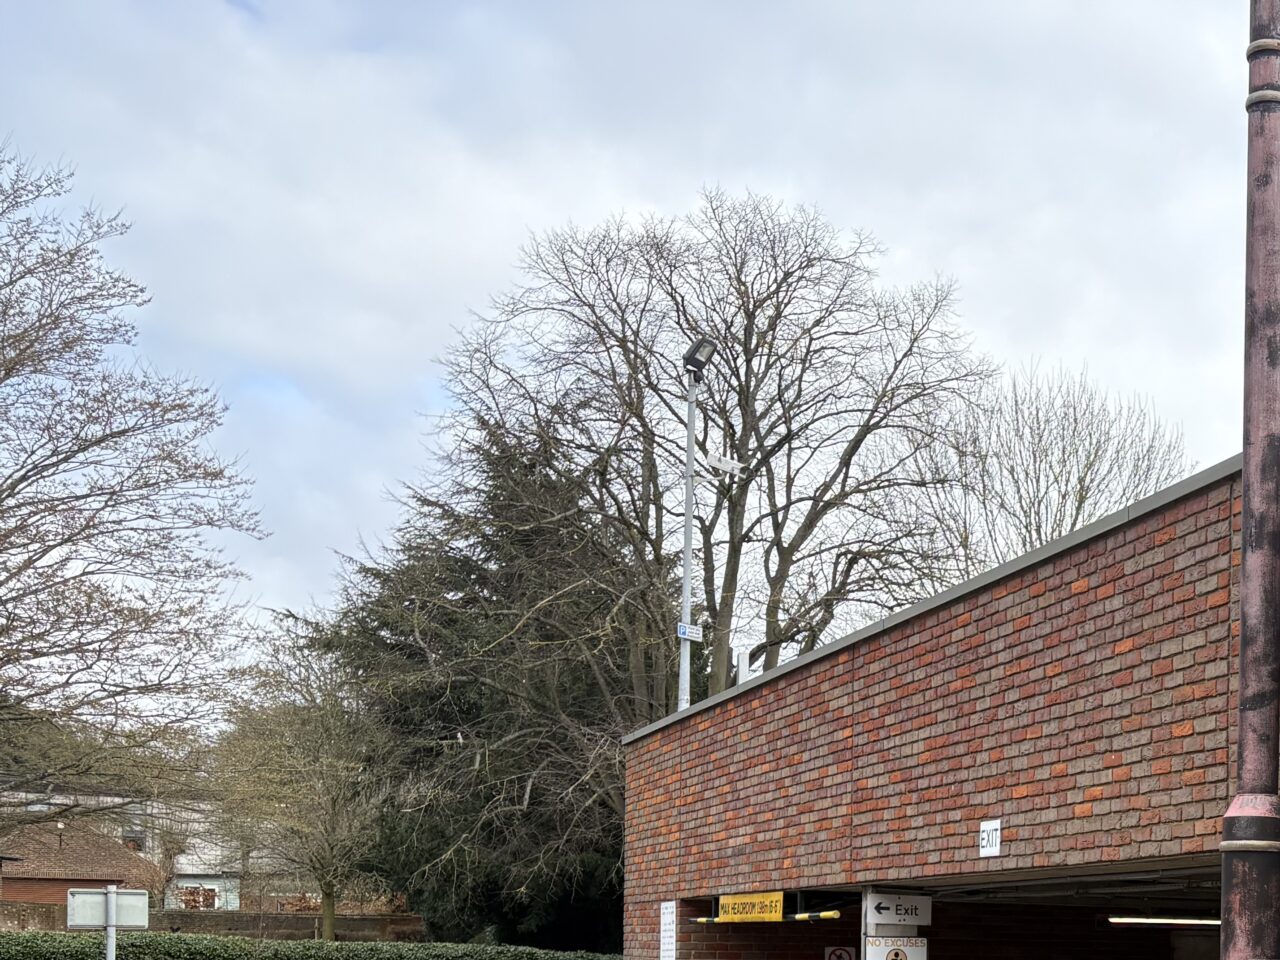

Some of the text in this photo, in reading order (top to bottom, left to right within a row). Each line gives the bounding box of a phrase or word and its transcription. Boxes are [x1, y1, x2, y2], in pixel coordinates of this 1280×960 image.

[981, 828, 999, 849] EXIT
[720, 903, 730, 916] MAX
[731, 901, 757, 915] HEADROOM
[895, 904, 919, 916] Exit
[866, 938, 926, 948] NO EXCUSES
